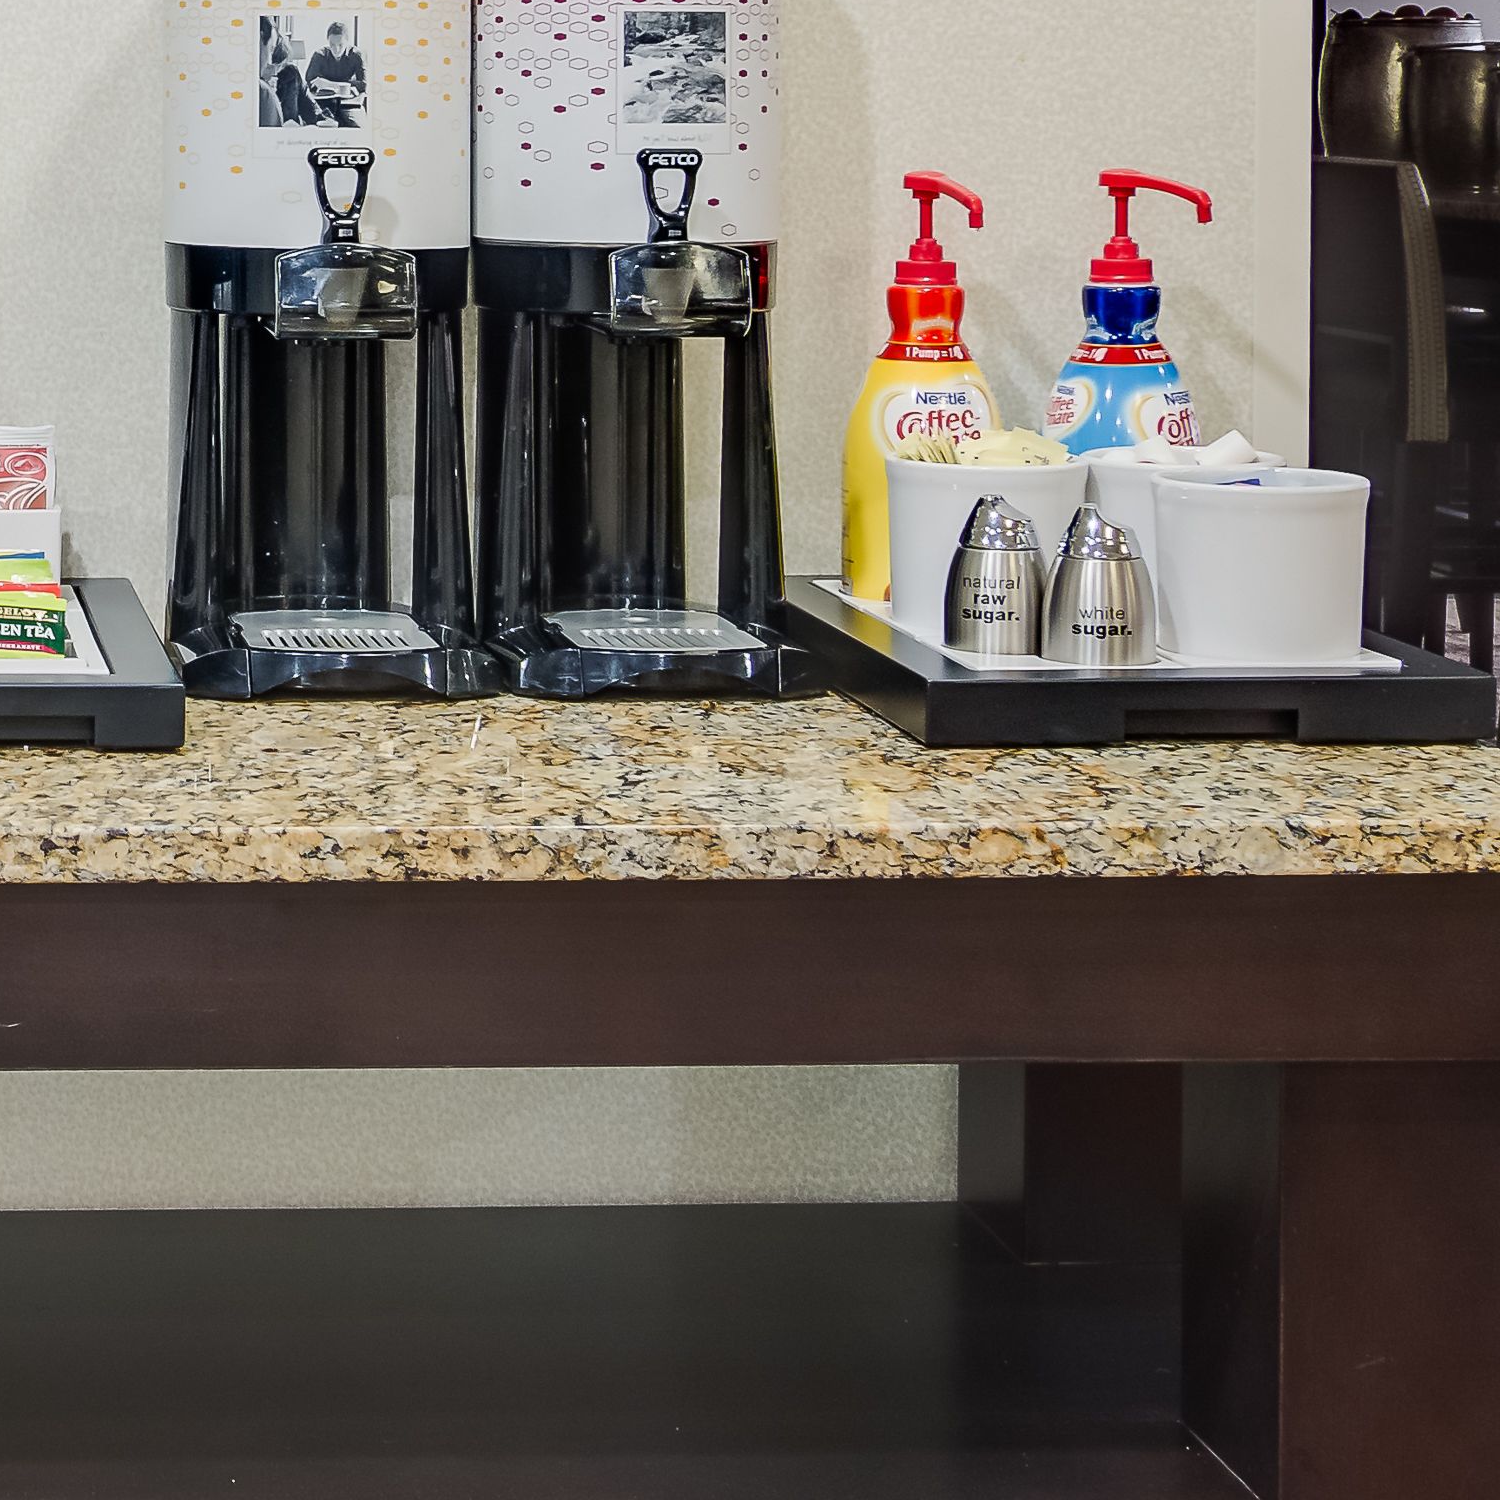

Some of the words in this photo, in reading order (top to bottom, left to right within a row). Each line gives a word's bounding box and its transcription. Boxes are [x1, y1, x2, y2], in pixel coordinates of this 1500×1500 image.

[317, 153, 370, 165] FETCO
[648, 153, 699, 166] FETCO
[963, 576, 1021, 590] natural
[973, 593, 1007, 606] raw
[961, 607, 1021, 624] sugar.
[1078, 606, 1126, 621] white
[23, 622, 56, 640] TEA
[1071, 623, 1133, 640] sugar.
